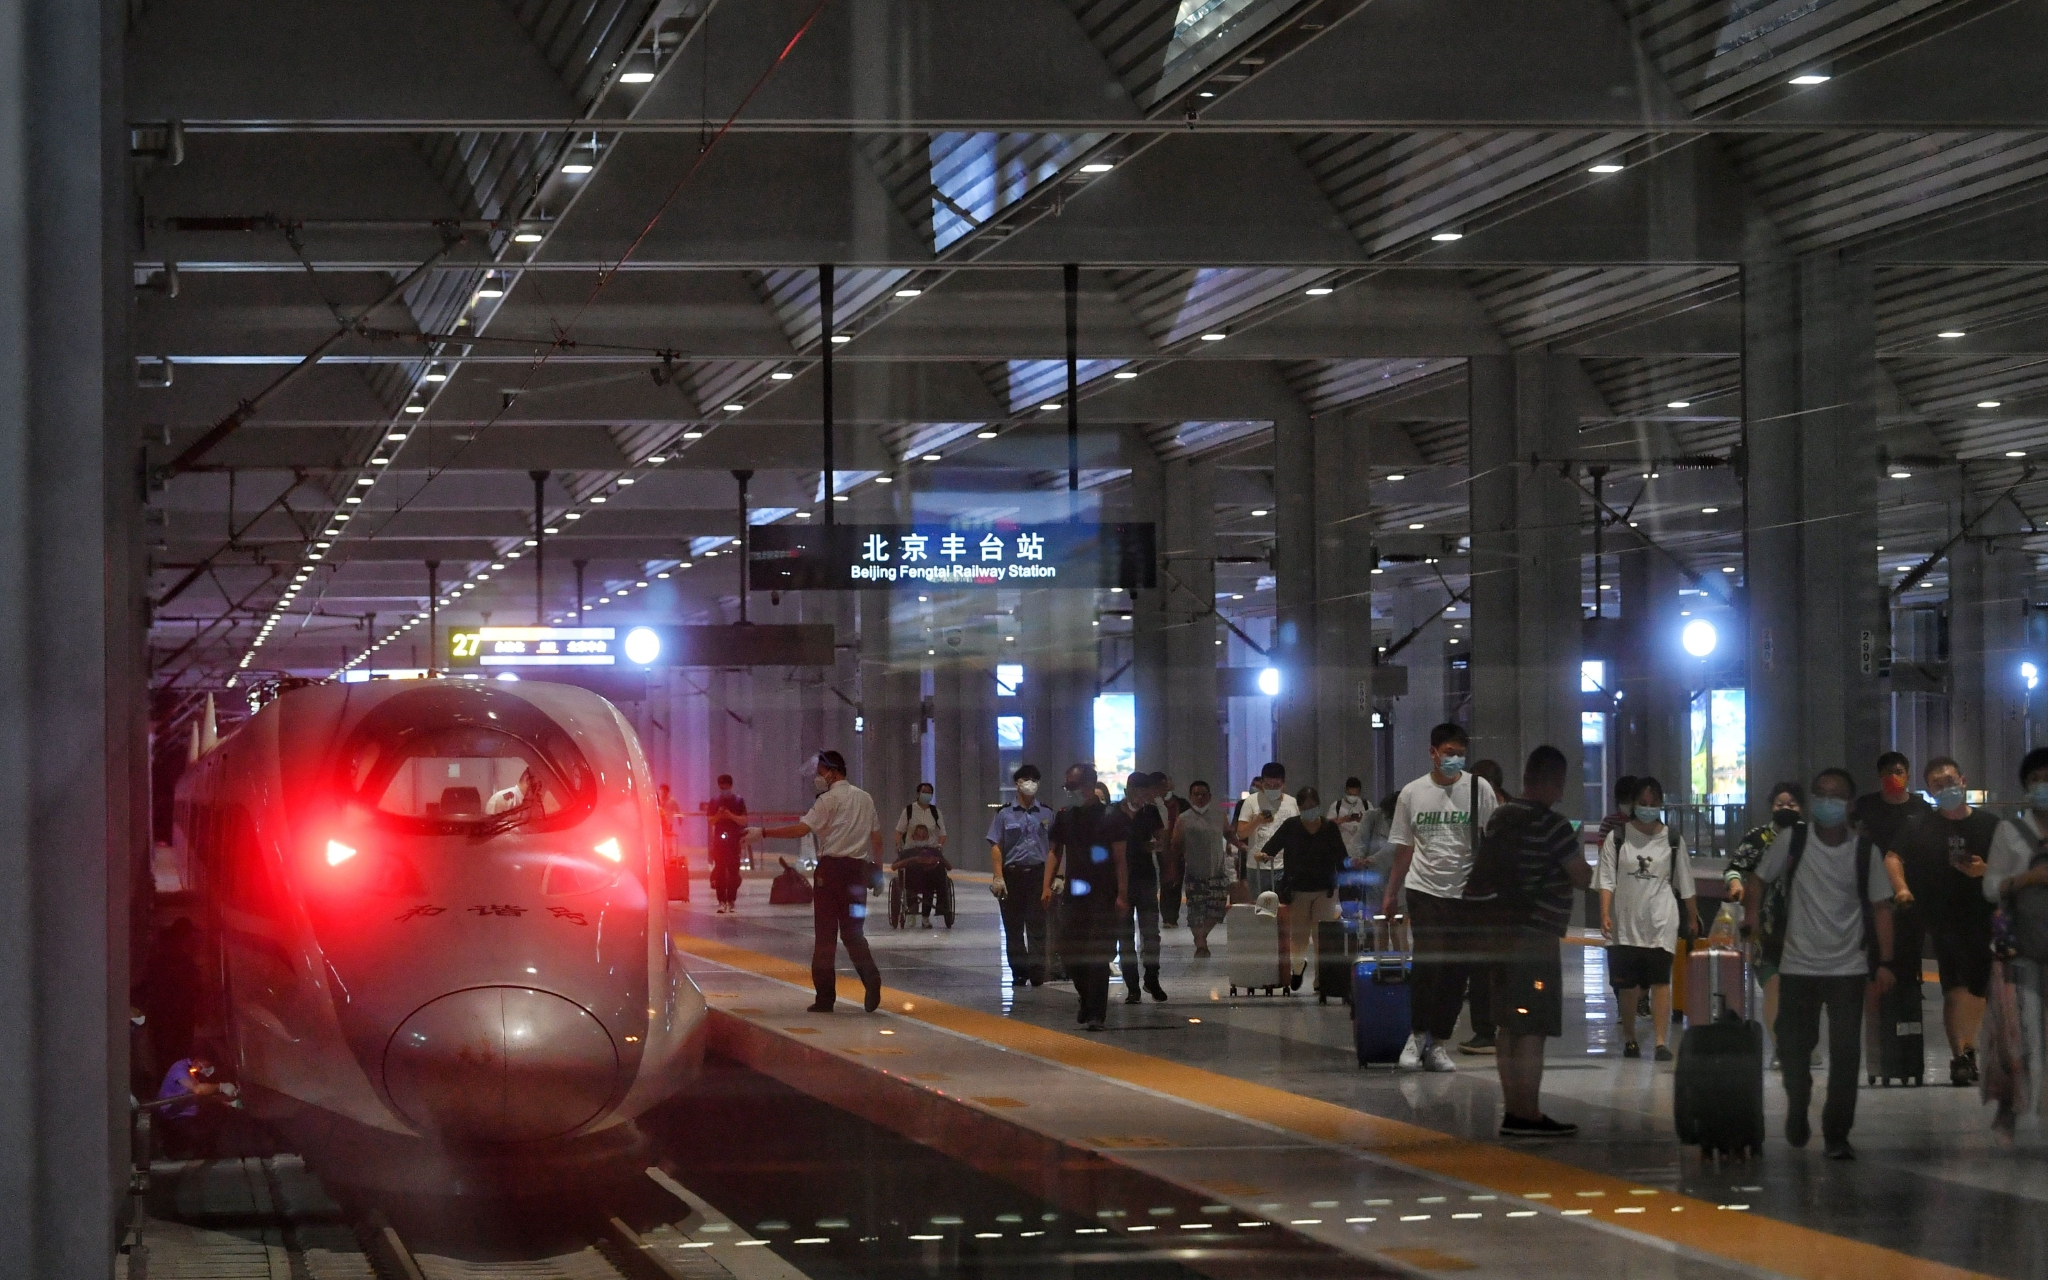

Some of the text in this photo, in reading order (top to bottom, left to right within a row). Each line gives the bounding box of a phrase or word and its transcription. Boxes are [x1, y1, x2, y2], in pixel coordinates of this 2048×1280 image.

[861, 532, 1045, 562] 北京丰台站
[851, 565, 897, 581] Beijing
[900, 565, 950, 581] Fengtai
[953, 564, 1006, 581] Railway
[1008, 564, 1056, 578] Station
[452, 633, 480, 656] 27
[1862, 631, 1870, 673] 2904
[394, 904, 588, 926] 和谐号
